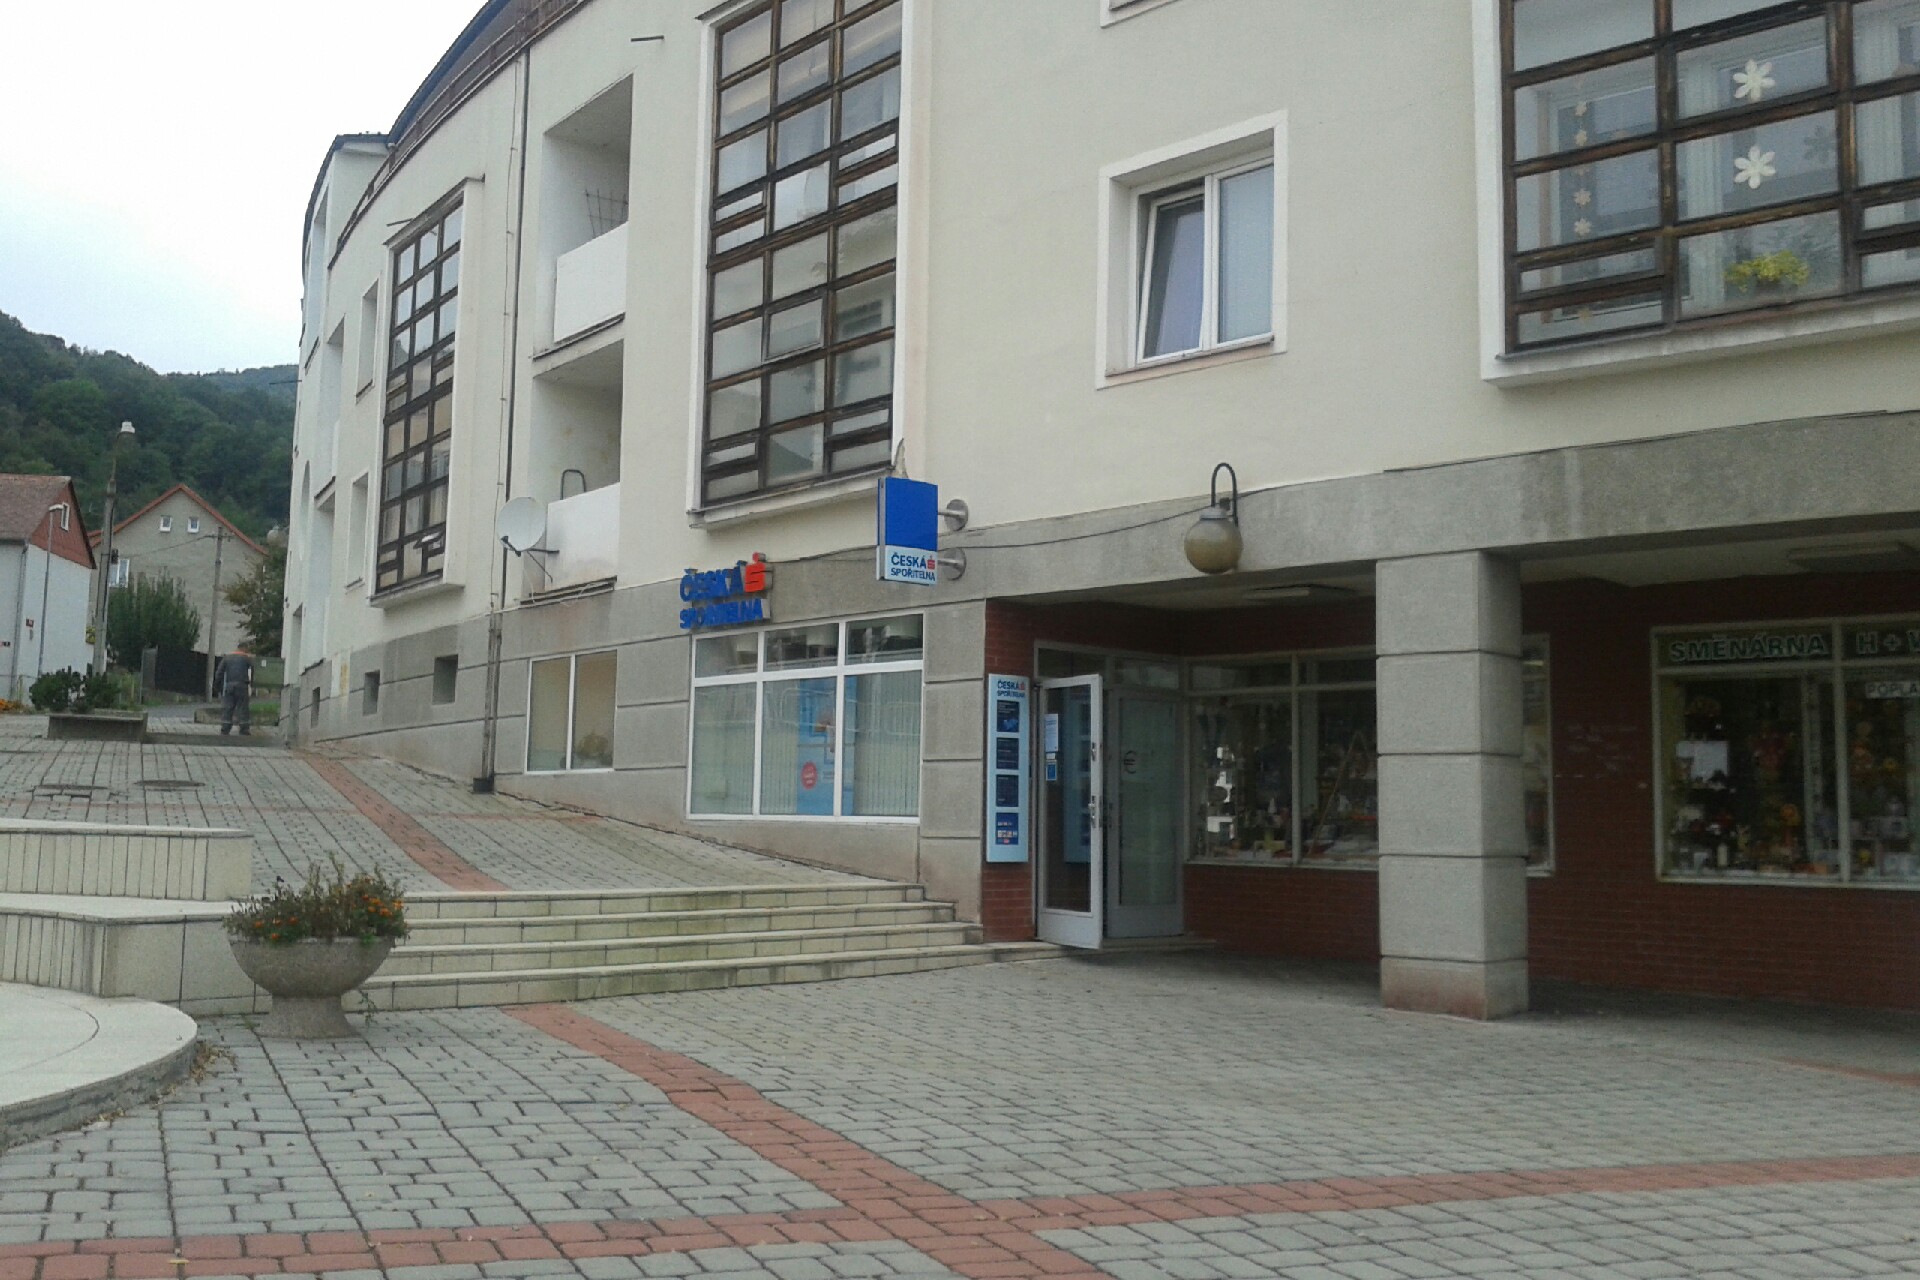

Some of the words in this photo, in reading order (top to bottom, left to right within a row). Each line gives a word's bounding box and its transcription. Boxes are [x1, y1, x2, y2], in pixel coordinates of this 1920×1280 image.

[891, 552, 926, 569] ČESKÁ
[680, 560, 747, 602] ČESKÁ
[890, 567, 936, 581] SPOŘITELNA
[1670, 632, 1829, 661] SMĚNÁRNA
[997, 678, 1020, 691] ČESKÁ
